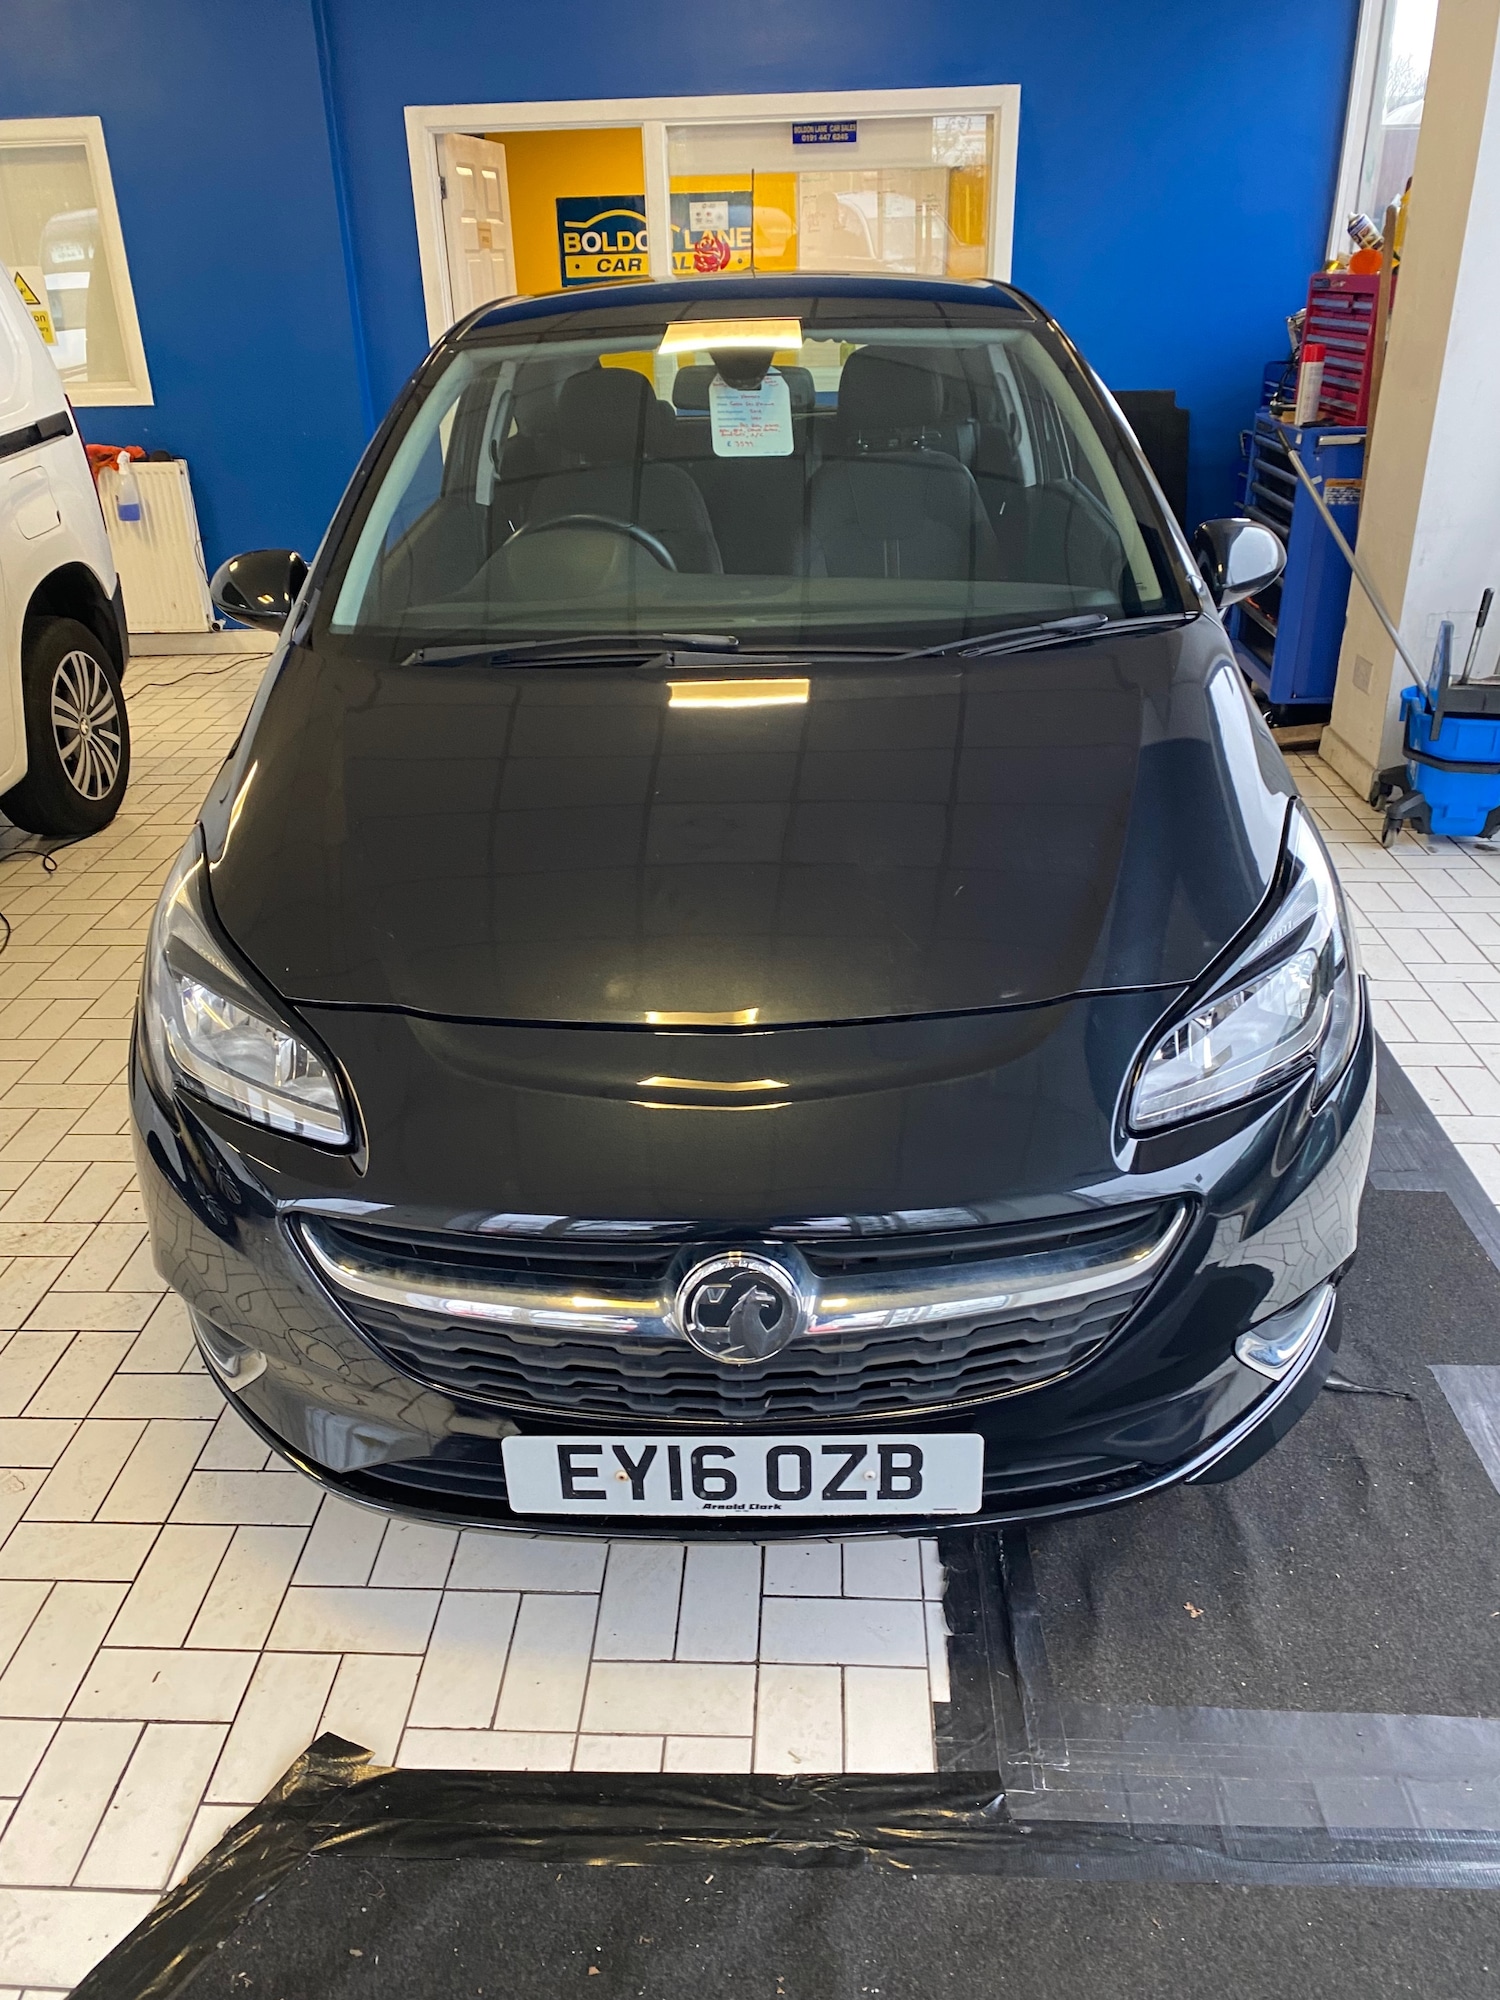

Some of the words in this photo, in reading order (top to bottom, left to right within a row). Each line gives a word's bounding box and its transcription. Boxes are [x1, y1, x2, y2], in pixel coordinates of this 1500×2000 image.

[563, 230, 649, 253] BOLDO
[597, 258, 642, 272] CAR
[557, 1444, 738, 1501] EY16
[766, 1443, 924, 1501] OZB
